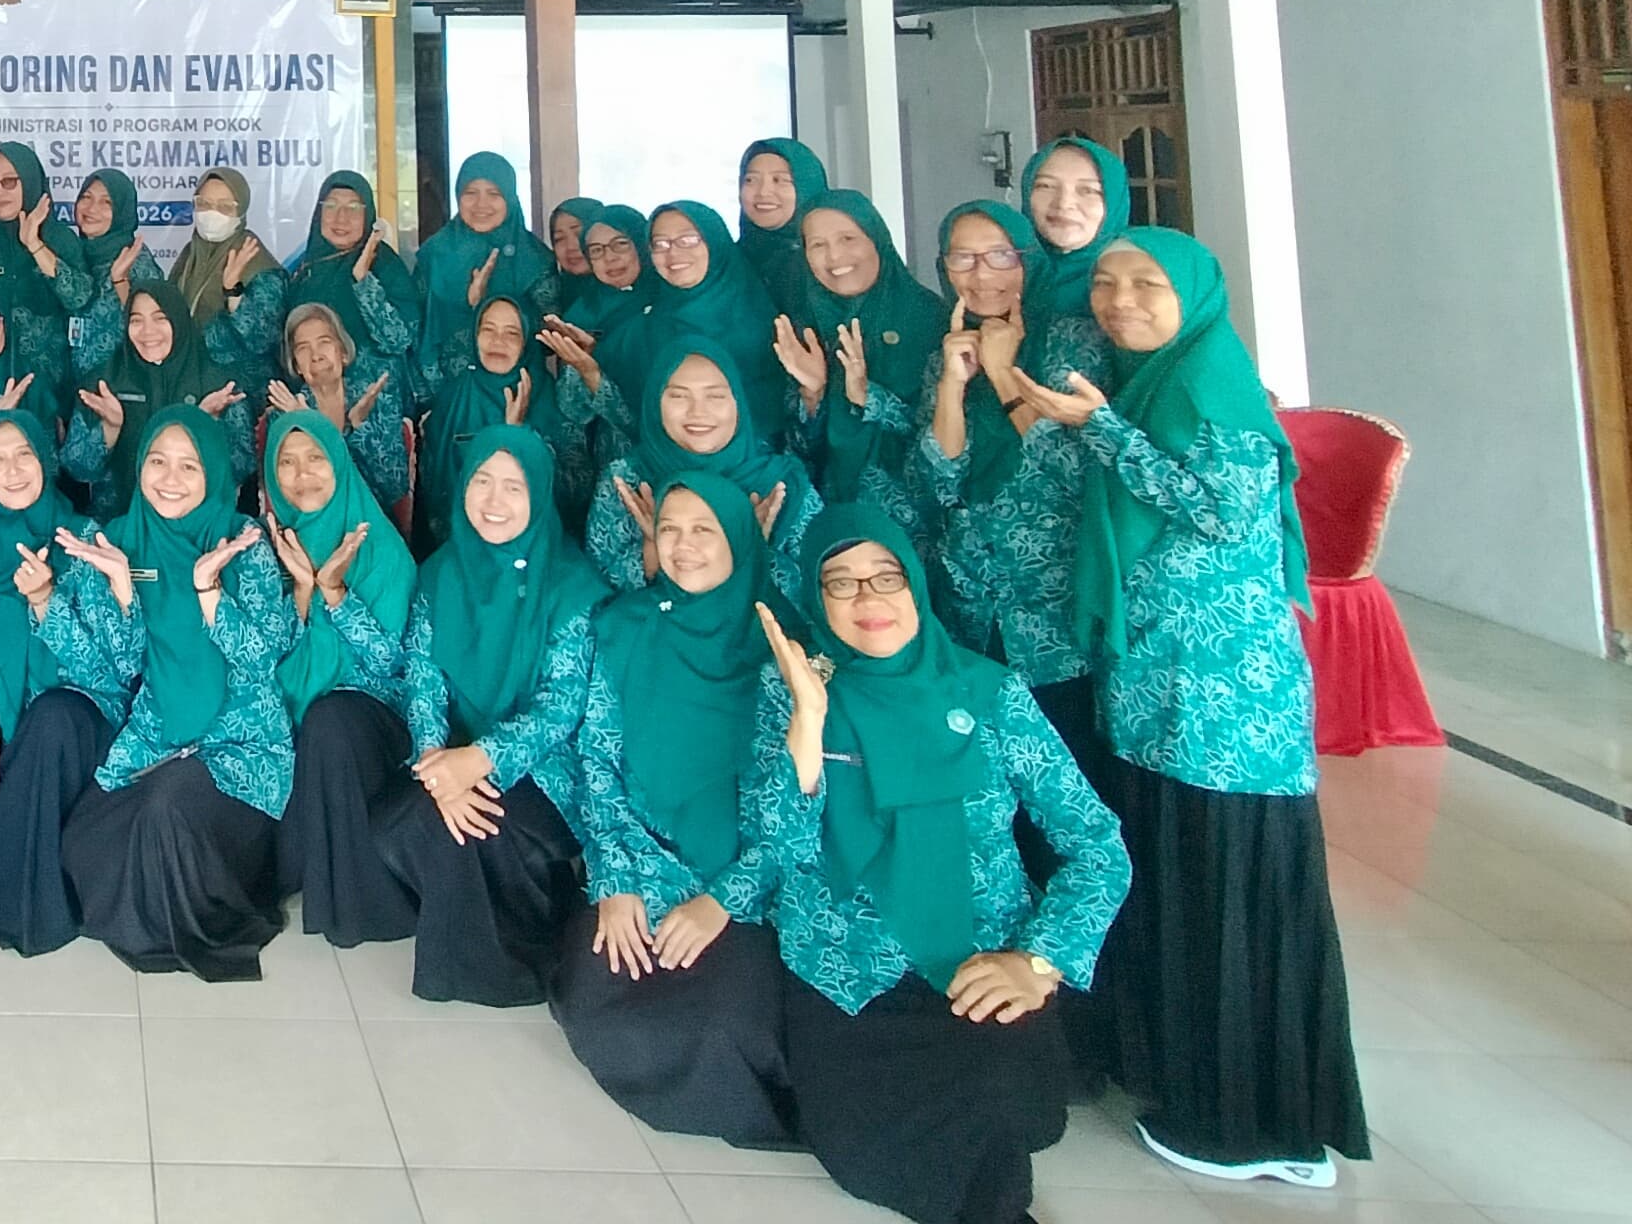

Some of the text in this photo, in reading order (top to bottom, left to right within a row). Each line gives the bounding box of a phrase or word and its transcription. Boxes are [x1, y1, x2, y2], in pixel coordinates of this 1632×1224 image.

[109, 55, 172, 92] DAN
[185, 54, 335, 92] EVALUASI
[89, 119, 107, 133] 10
[113, 118, 198, 132] PROGRAM
[204, 118, 262, 132] POKOK
[49, 140, 82, 167] SE
[92, 140, 248, 167] KECAMATAN
[258, 140, 322, 166] BULU
[132, 176, 198, 189] KOHAR
[137, 205, 172, 222] 026
